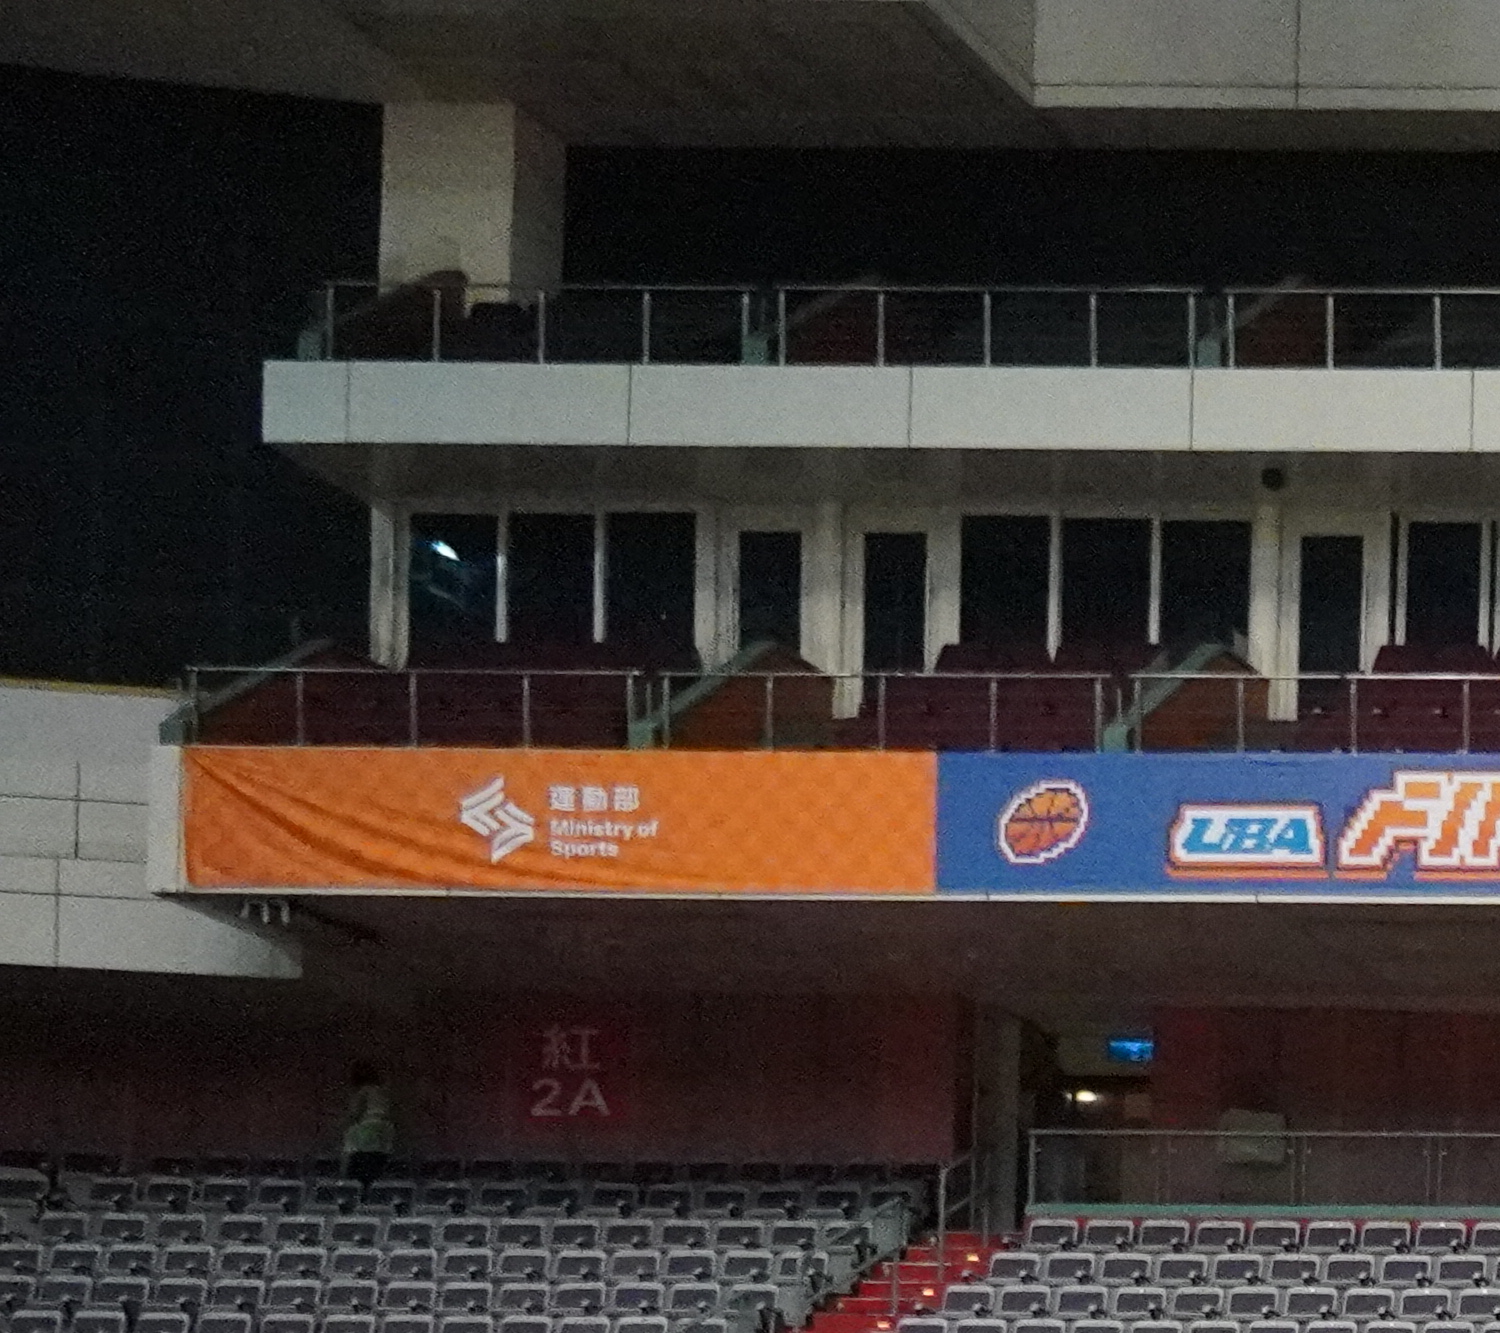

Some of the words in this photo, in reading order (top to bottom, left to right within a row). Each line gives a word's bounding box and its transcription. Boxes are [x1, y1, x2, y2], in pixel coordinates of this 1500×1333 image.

[550, 820, 634, 840] Ministry
[637, 821, 659, 838] of
[550, 840, 619, 859] Sports
[542, 1027, 599, 1071] 紅
[531, 1079, 609, 1117] 2A
